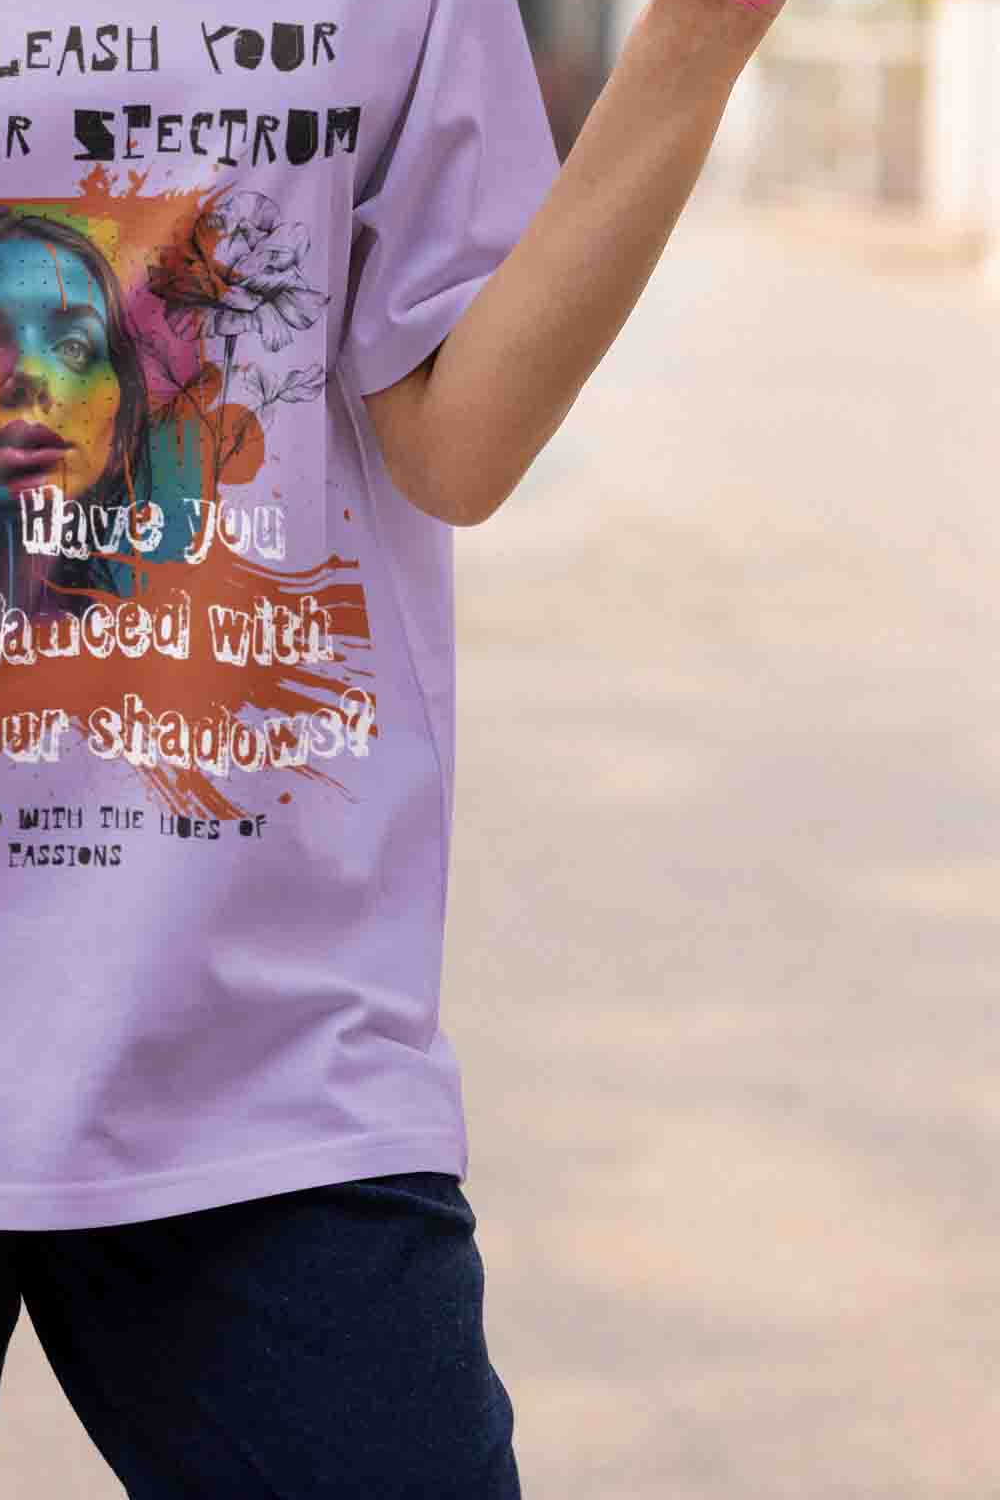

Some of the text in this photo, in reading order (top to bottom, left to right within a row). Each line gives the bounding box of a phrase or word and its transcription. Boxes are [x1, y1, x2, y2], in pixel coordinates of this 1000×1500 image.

[200, 20, 339, 75] YOUR
[72, 104, 362, 167] SPECTRUM
[19, 484, 287, 564] Have you
[207, 595, 335, 667] with
[87, 688, 378, 776] shadows?
[18, 806, 84, 831] WITH
[99, 806, 145, 831] THE
[160, 813, 221, 840] HUES
[238, 812, 271, 840] OF
[7, 842, 123, 869] PASSIONS
